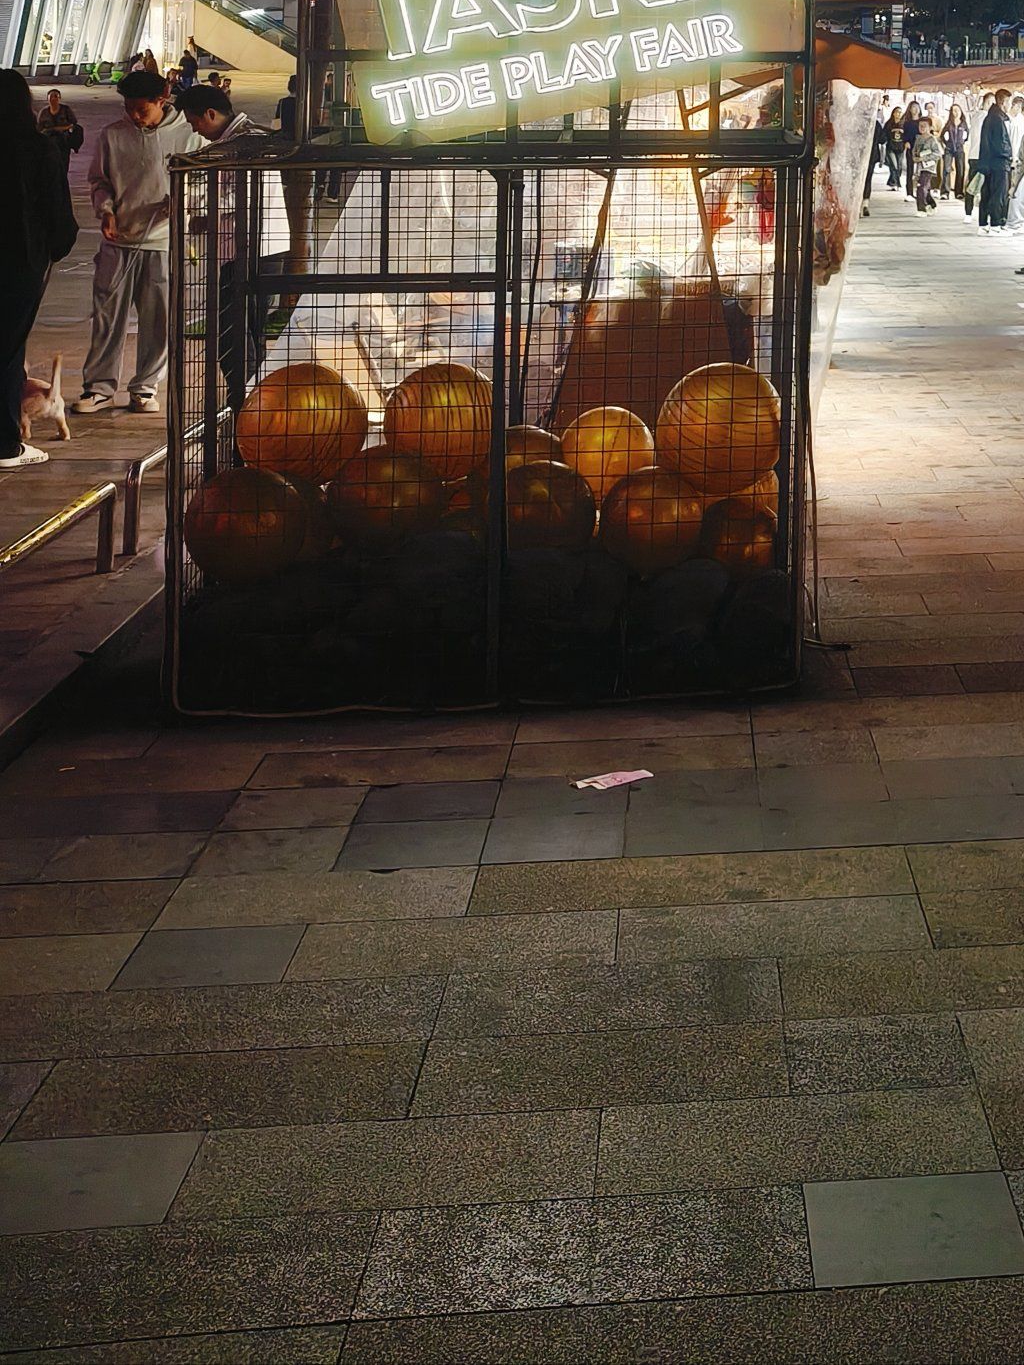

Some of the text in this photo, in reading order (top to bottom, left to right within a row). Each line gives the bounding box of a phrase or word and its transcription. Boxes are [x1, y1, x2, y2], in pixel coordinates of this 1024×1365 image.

[371, 14, 744, 126] TIDE PLAY FAIR
